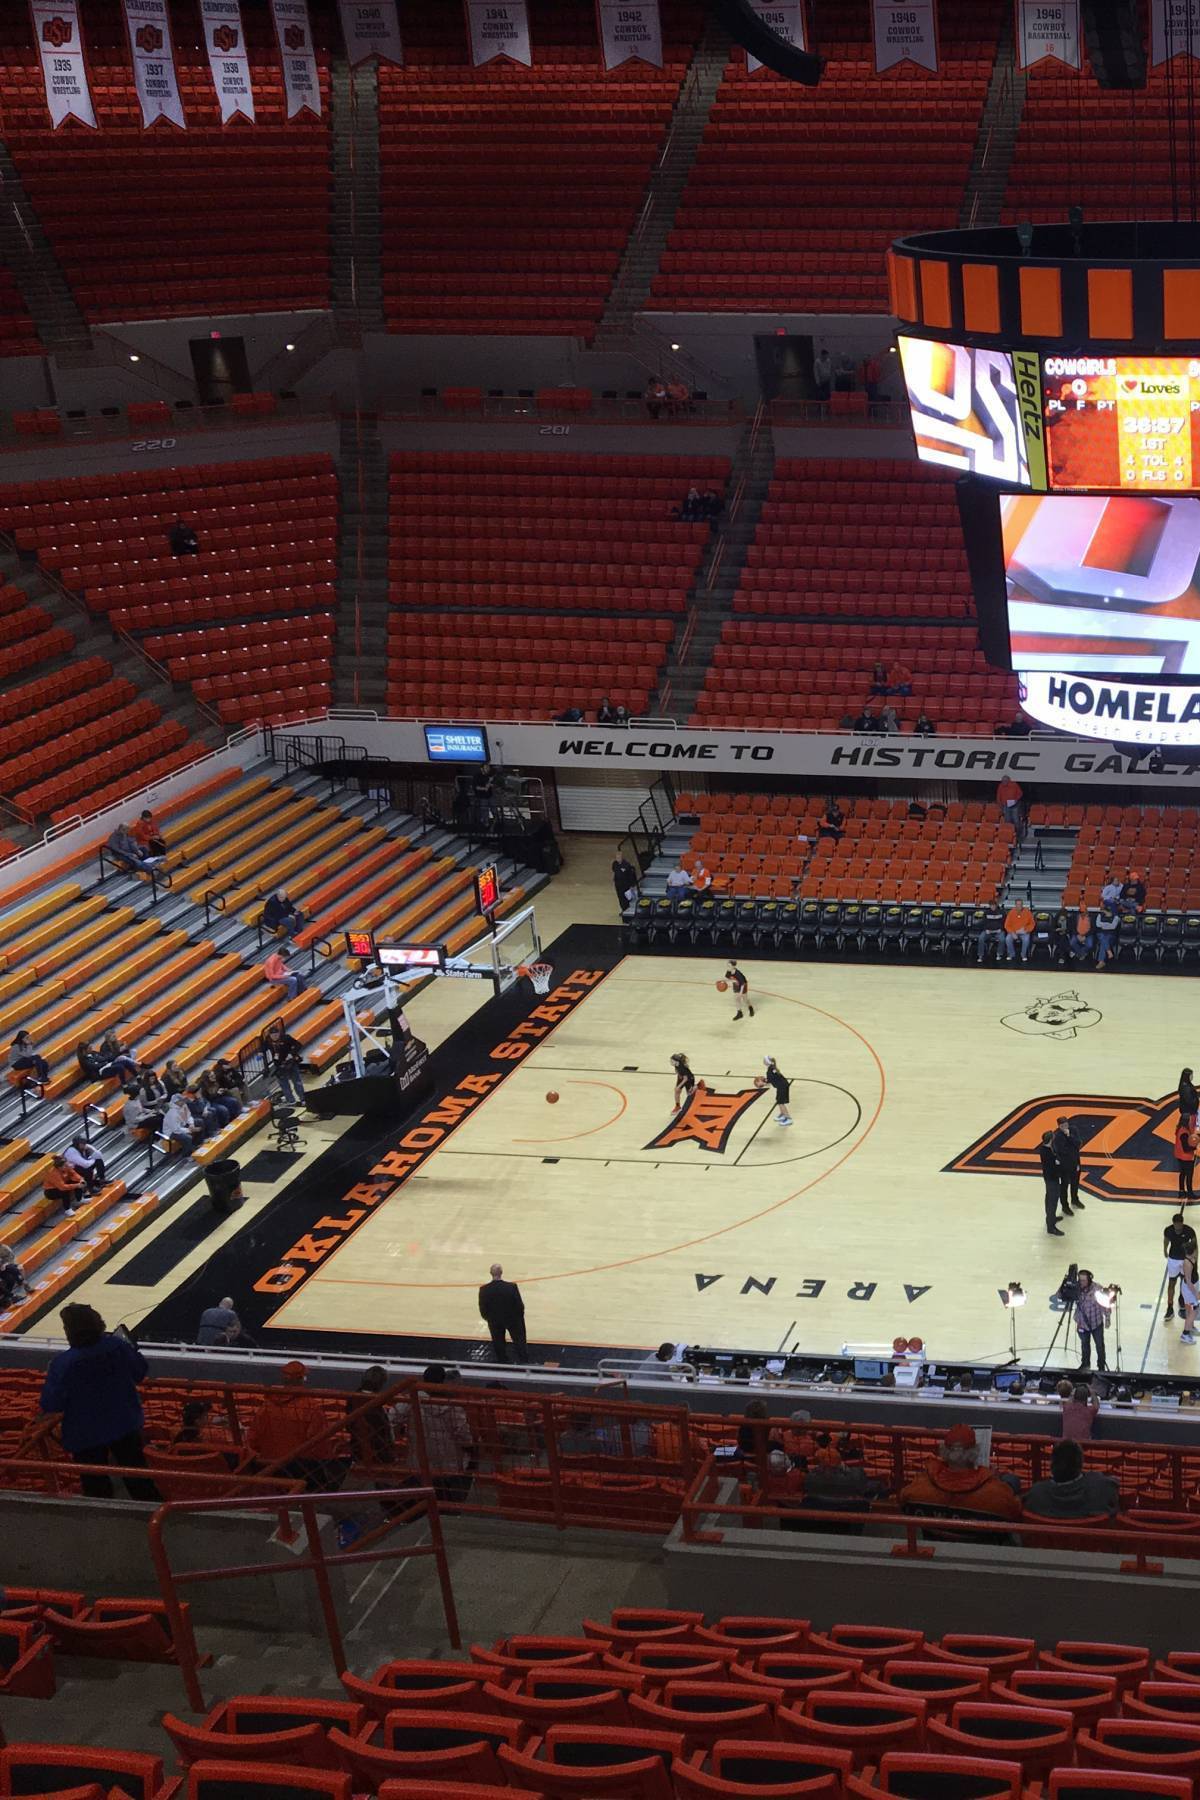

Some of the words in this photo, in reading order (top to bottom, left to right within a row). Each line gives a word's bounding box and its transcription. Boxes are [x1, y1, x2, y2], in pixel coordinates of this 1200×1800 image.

[486, 9, 508, 19] 1941
[618, 12, 643, 22] 1942
[760, 13, 785, 23] 1945
[891, 13, 916, 23] 1946
[1036, 9, 1061, 20] 1946
[483, 23, 514, 31] COWBOY
[615, 25, 648, 33] COWBOY
[1032, 23, 1065, 31] COWBOY
[1165, 20, 1200, 28] COWBOY
[481, 31, 519, 39] WRESTLING
[888, 27, 920, 35] COWBOY
[1028, 32, 1071, 40] BASKETBALL
[614, 34, 651, 42] WRESTLING
[1045, 44, 1054, 52] 16
[53, 60, 72, 71] 1935
[145, 64, 164, 76] 1937
[52, 76, 77, 85] COWBOY
[146, 79, 169, 89] COWBOY
[52, 87, 81, 95] WRESTLING
[1044, 358, 1117, 376] COWGIRLS
[1071, 378, 1088, 396] 0
[1016, 358, 1041, 441] Hertz
[1048, 400, 1066, 411] PL
[1076, 400, 1085, 411] F
[1097, 400, 1116, 411] PT
[539, 425, 570, 435] 201
[1123, 416, 1186, 434] 36:57
[131, 438, 177, 452] 220
[1141, 438, 1167, 451] 1ST
[1142, 456, 1168, 467] TOL
[1126, 471, 1136, 481] 0
[1142, 470, 1167, 481] FLS
[1174, 471, 1184, 481] 0
[445, 735, 481, 745] SHELTER
[558, 740, 720, 759] WELCOME
[730, 745, 775, 761] TO
[831, 746, 1041, 770] HISTORIC
[353, 942, 368, 954] 30
[489, 969, 605, 1061] STATE
[253, 1071, 502, 1293] OKLAHOMA
[694, 1273, 933, 1304] ARENA
